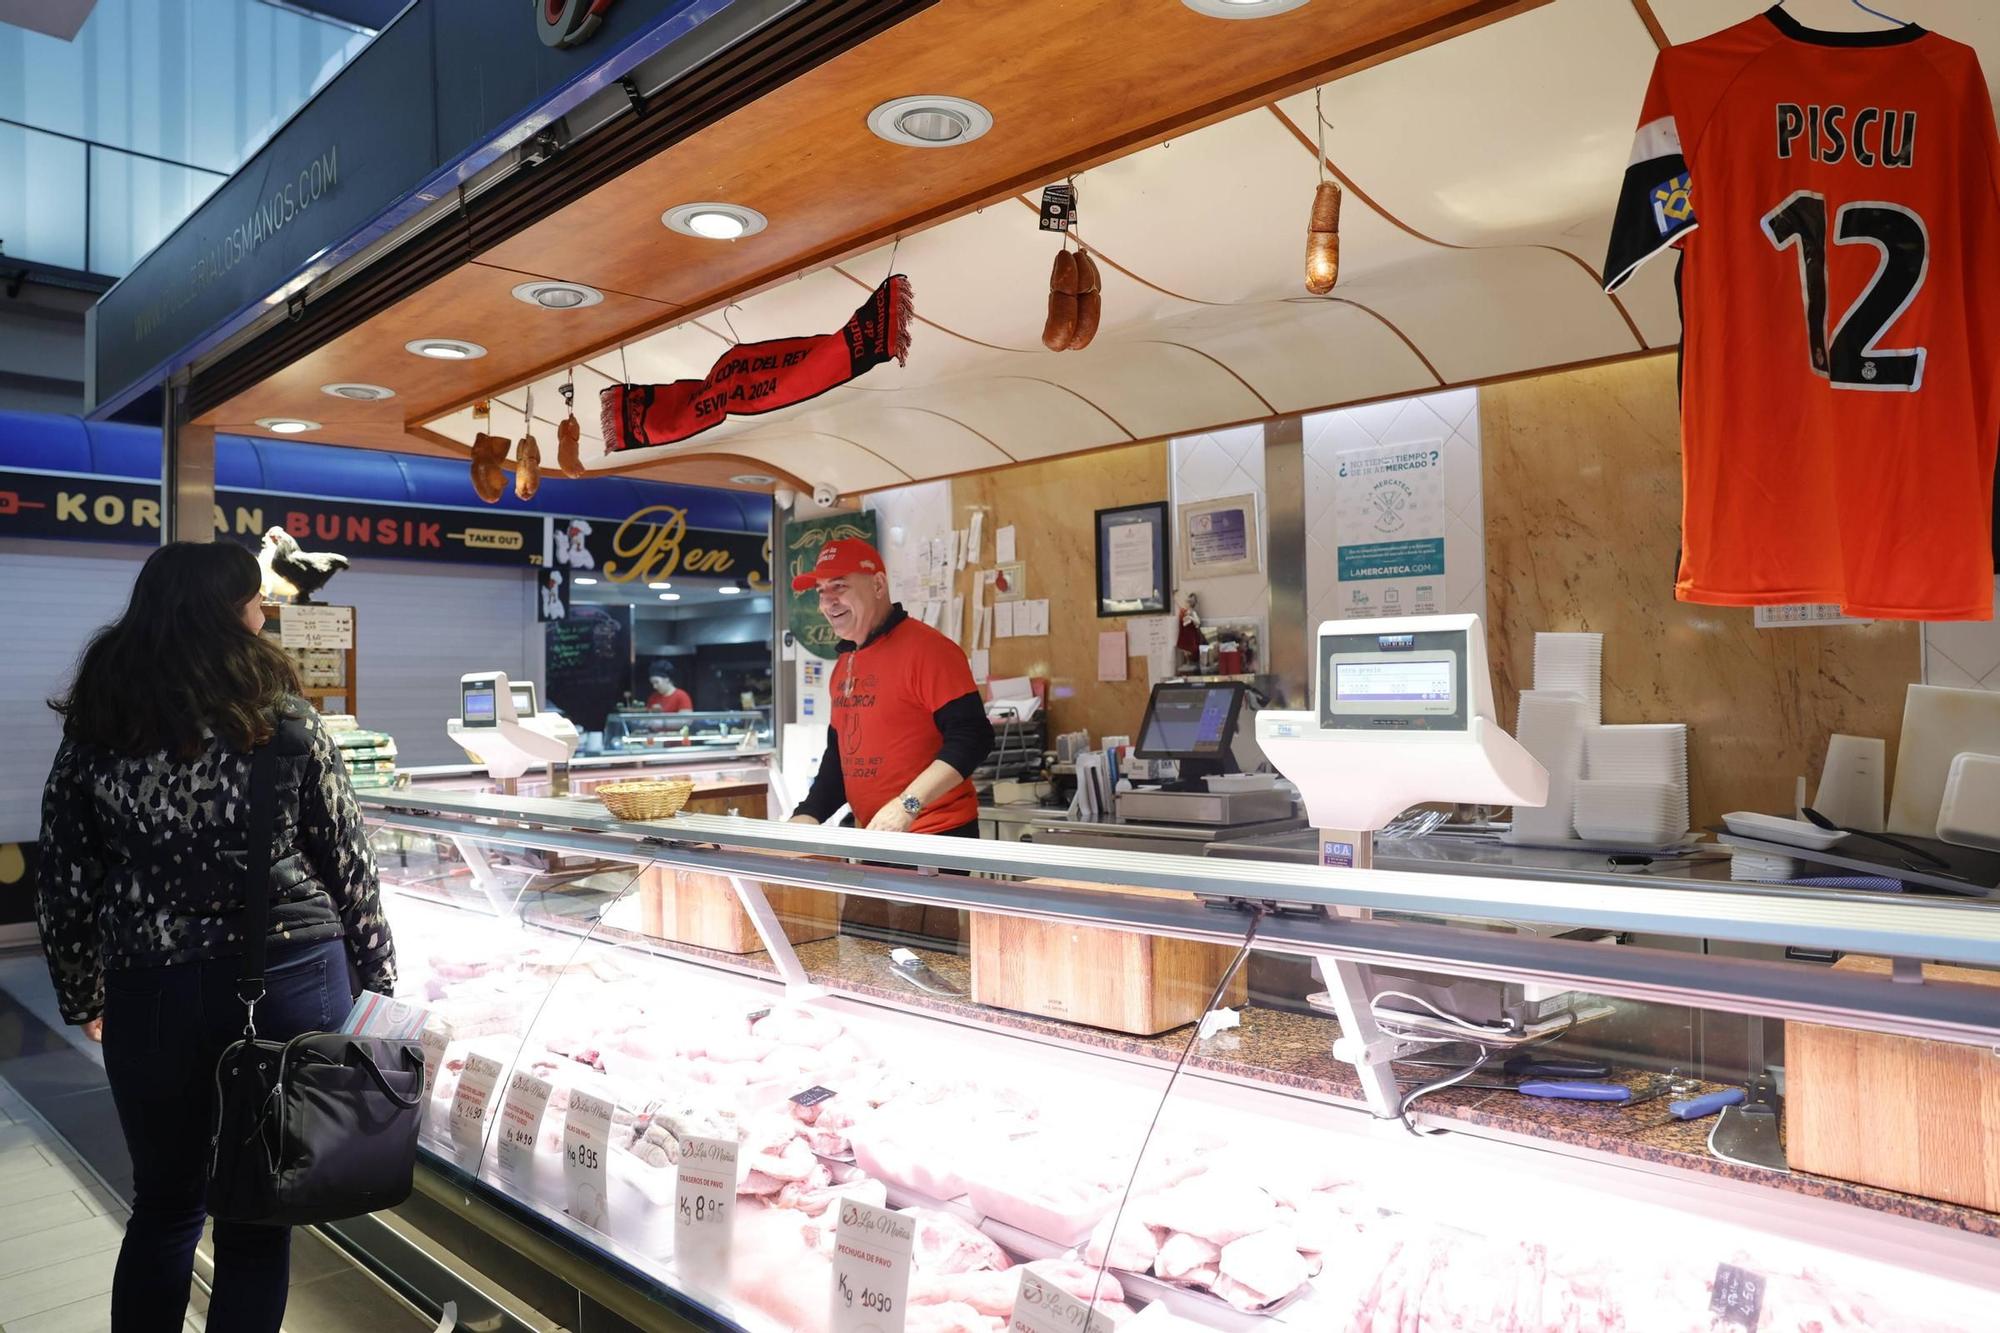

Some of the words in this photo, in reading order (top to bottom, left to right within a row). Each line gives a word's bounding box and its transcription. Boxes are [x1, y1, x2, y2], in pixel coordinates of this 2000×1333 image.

[1776, 103, 1917, 168] PISCU
[1760, 189, 1929, 393] 12
[715, 359, 749, 383] COPA
[752, 355, 777, 372] DEL
[749, 377, 777, 400] 2024
[1386, 461, 1427, 472] MERCADO
[1396, 452, 1427, 462] TIEMPO
[287, 512, 441, 547] BUNSIK
[468, 533, 495, 544] TAKE
[498, 535, 519, 546] OUT
[603, 505, 735, 584] Ben
[1325, 842, 1351, 856] SCA
[567, 1144, 576, 1167] Kg
[680, 1174, 703, 1185] TRASEROS
[710, 1180, 724, 1190] PAVO
[680, 1195, 691, 1226] Kg
[838, 1243, 866, 1261] PECHUGA
[875, 1256, 892, 1269] PAVO
[838, 1272, 853, 1308] Kg
